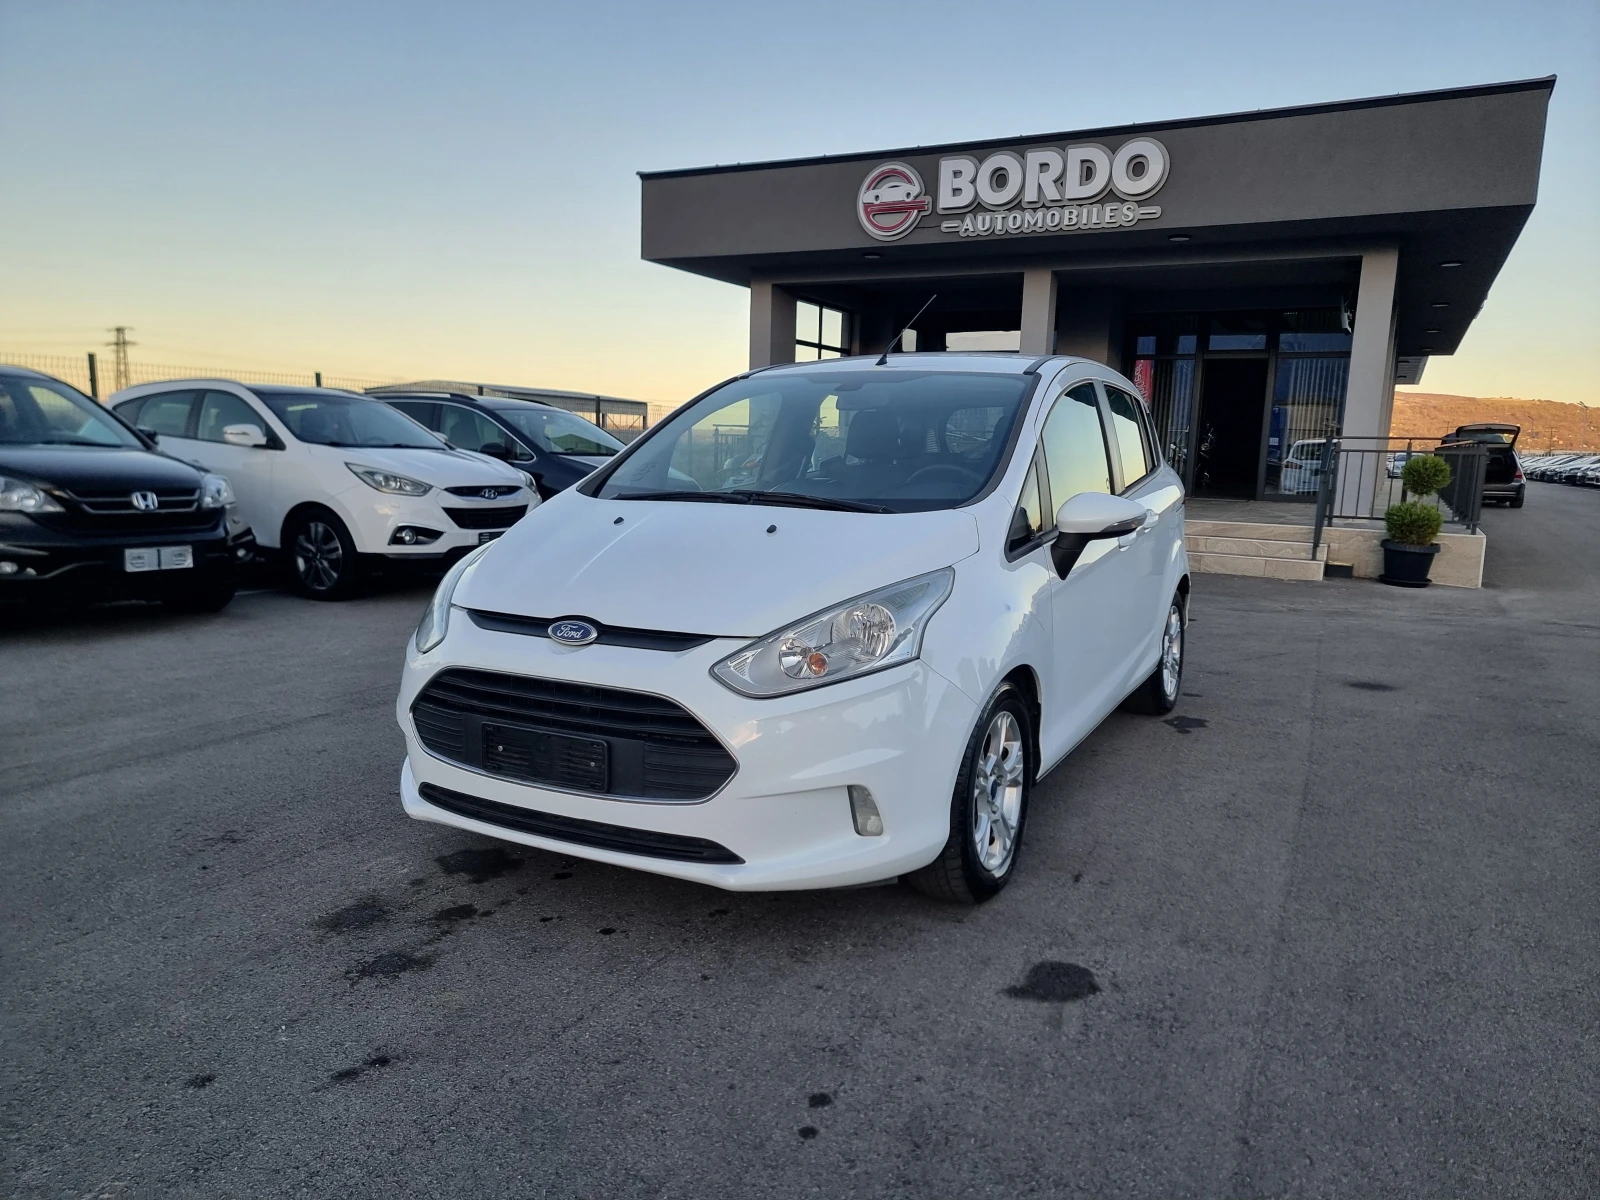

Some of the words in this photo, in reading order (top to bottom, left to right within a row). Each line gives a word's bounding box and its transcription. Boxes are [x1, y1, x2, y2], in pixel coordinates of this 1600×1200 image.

[937, 139, 1167, 210] BORDO
[961, 204, 1136, 233] AUTOMOBILES
[556, 624, 584, 639] Ford
